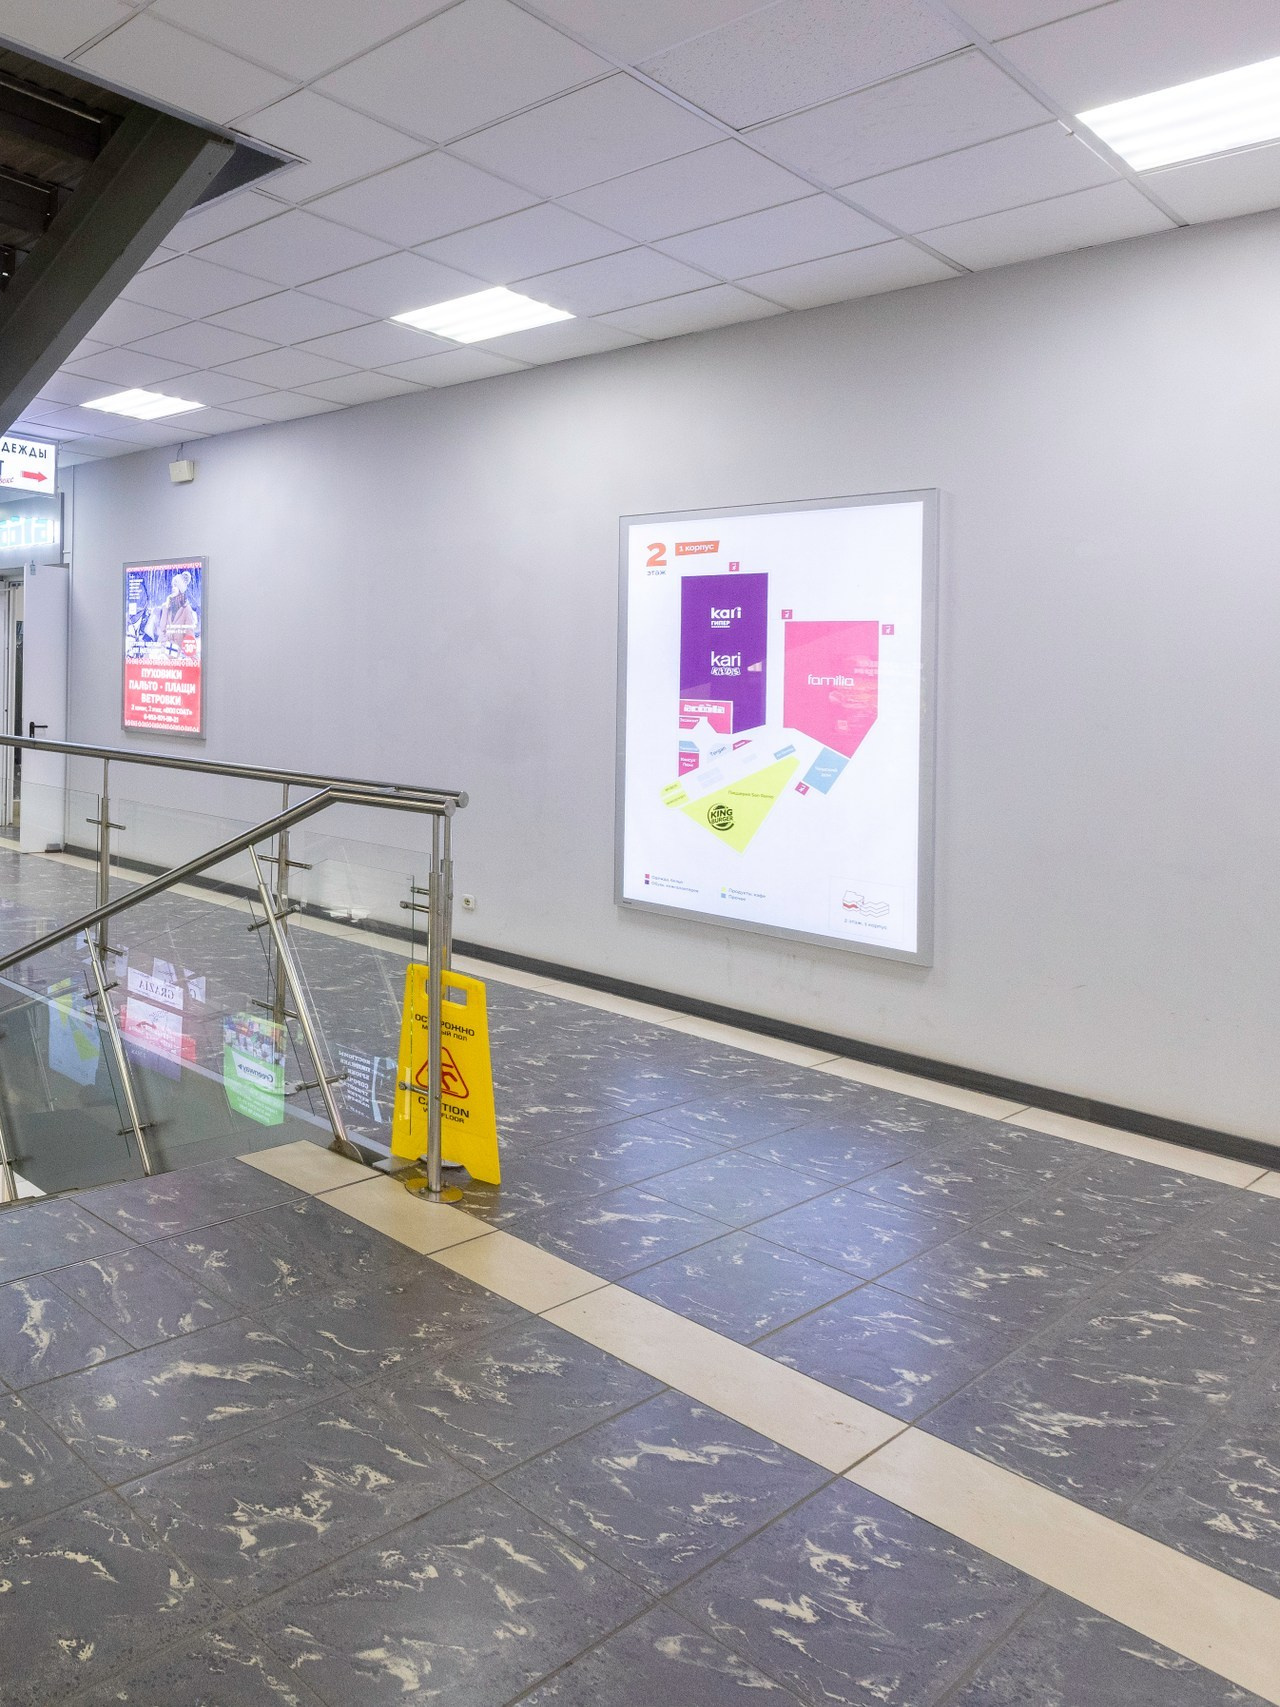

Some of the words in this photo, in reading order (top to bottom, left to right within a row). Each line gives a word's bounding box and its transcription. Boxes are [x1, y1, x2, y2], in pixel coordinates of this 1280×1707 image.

[685, 544, 715, 552] корпус
[645, 543, 667, 567] 2
[711, 607, 741, 619] kari
[711, 651, 741, 667] kari
[141, 668, 183, 680] ПУХОВИКИ
[808, 674, 854, 687] familia
[129, 680, 158, 691] ПАЛЬТО
[165, 682, 196, 695] ПЛАЩИ
[141, 693, 182, 706] ВЕТРОВКИ
[710, 808, 733, 819] KING
[711, 816, 734, 824] BURGER
[418, 1096, 470, 1118] CTION
